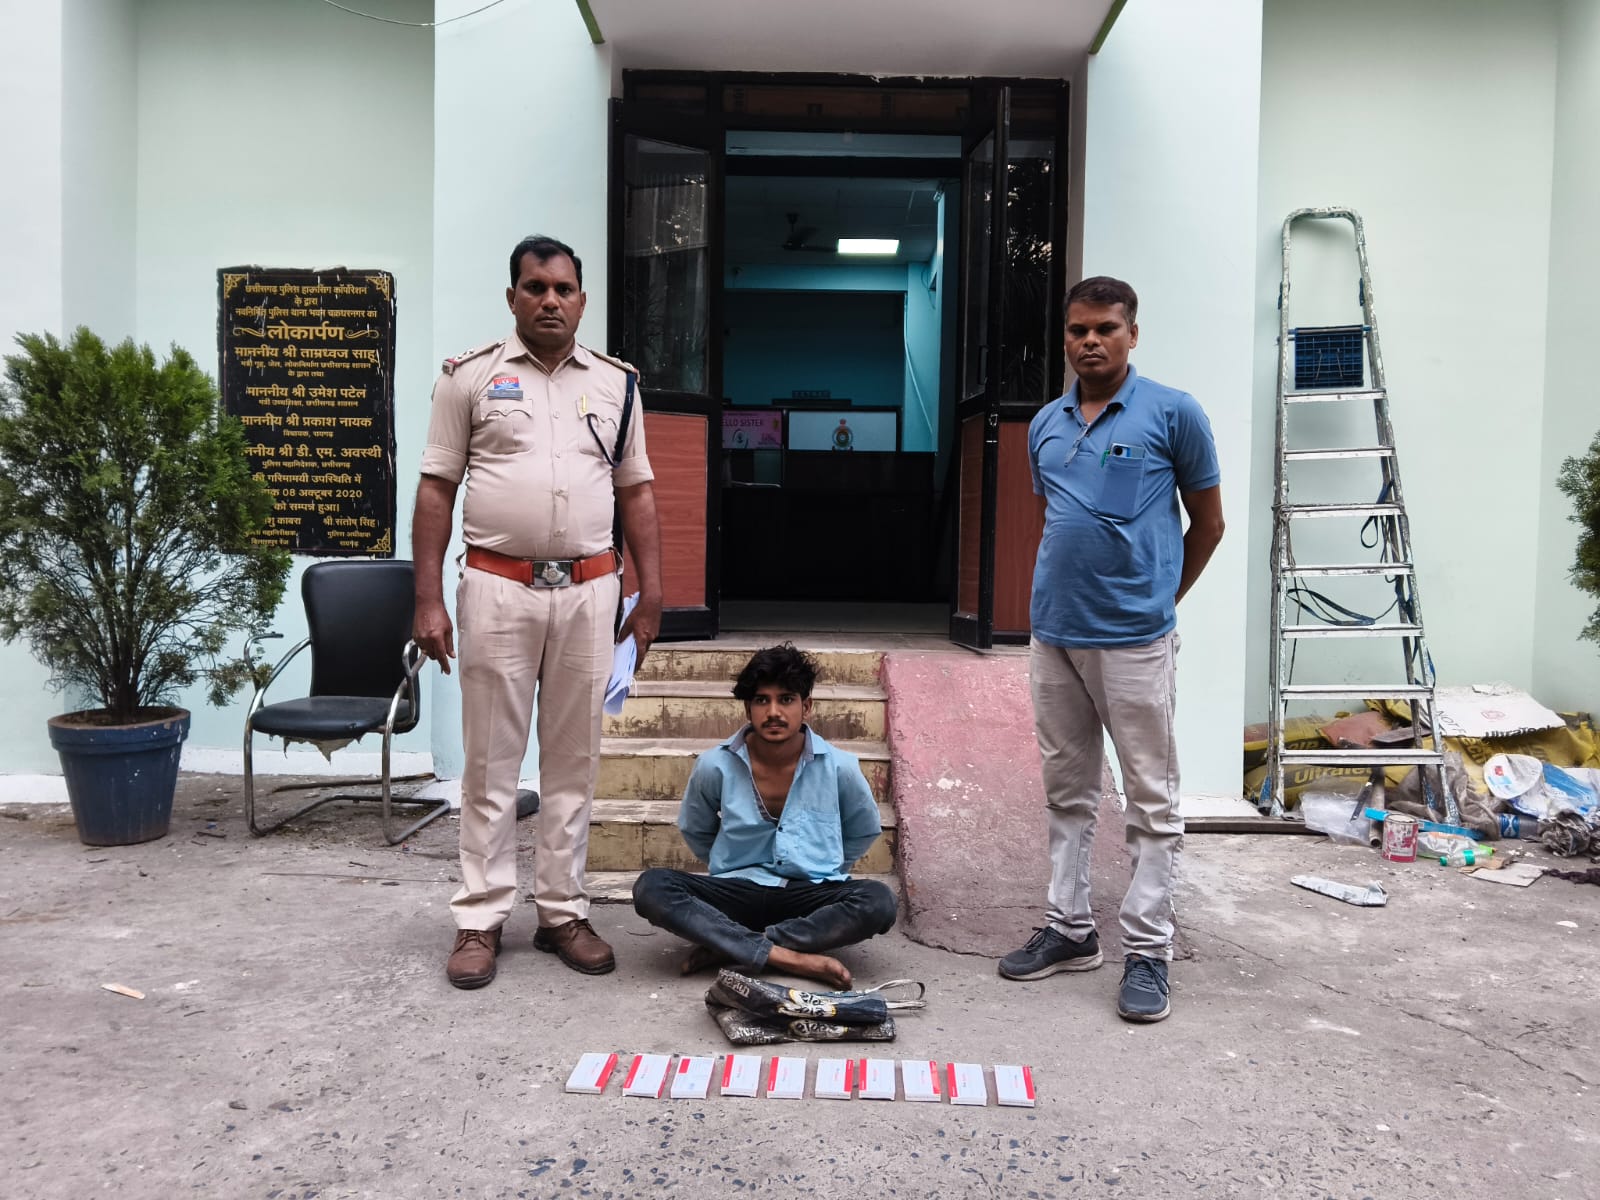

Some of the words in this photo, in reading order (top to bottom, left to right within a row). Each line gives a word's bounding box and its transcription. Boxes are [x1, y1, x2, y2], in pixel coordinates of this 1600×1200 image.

[280, 282, 300, 296] पुलिस
[294, 296, 302, 306] के
[268, 306, 289, 320] पुलिस
[367, 310, 378, 319] का
[266, 319, 346, 341] लोकार्पण
[234, 344, 280, 359] माननीय
[282, 344, 297, 360] श्री
[351, 348, 379, 364] साहू
[246, 383, 289, 398] माननीय
[291, 383, 305, 398] श्री
[308, 384, 337, 399] उमेश
[340, 385, 367, 399] पटेल
[241, 412, 282, 427] माननीय
[286, 412, 300, 427] श्री
[303, 416, 336, 428] प्रकाश
[339, 416, 373, 428] नायक
[279, 443, 293, 457] श्री
[296, 444, 313, 457] डी.
[316, 447, 337, 459] एम.
[340, 444, 382, 458] अवस्थी
[354, 473, 363, 484] में
[282, 488, 296, 497] 08
[298, 488, 333, 500] अक्टूबर
[335, 489, 363, 498] 2020
